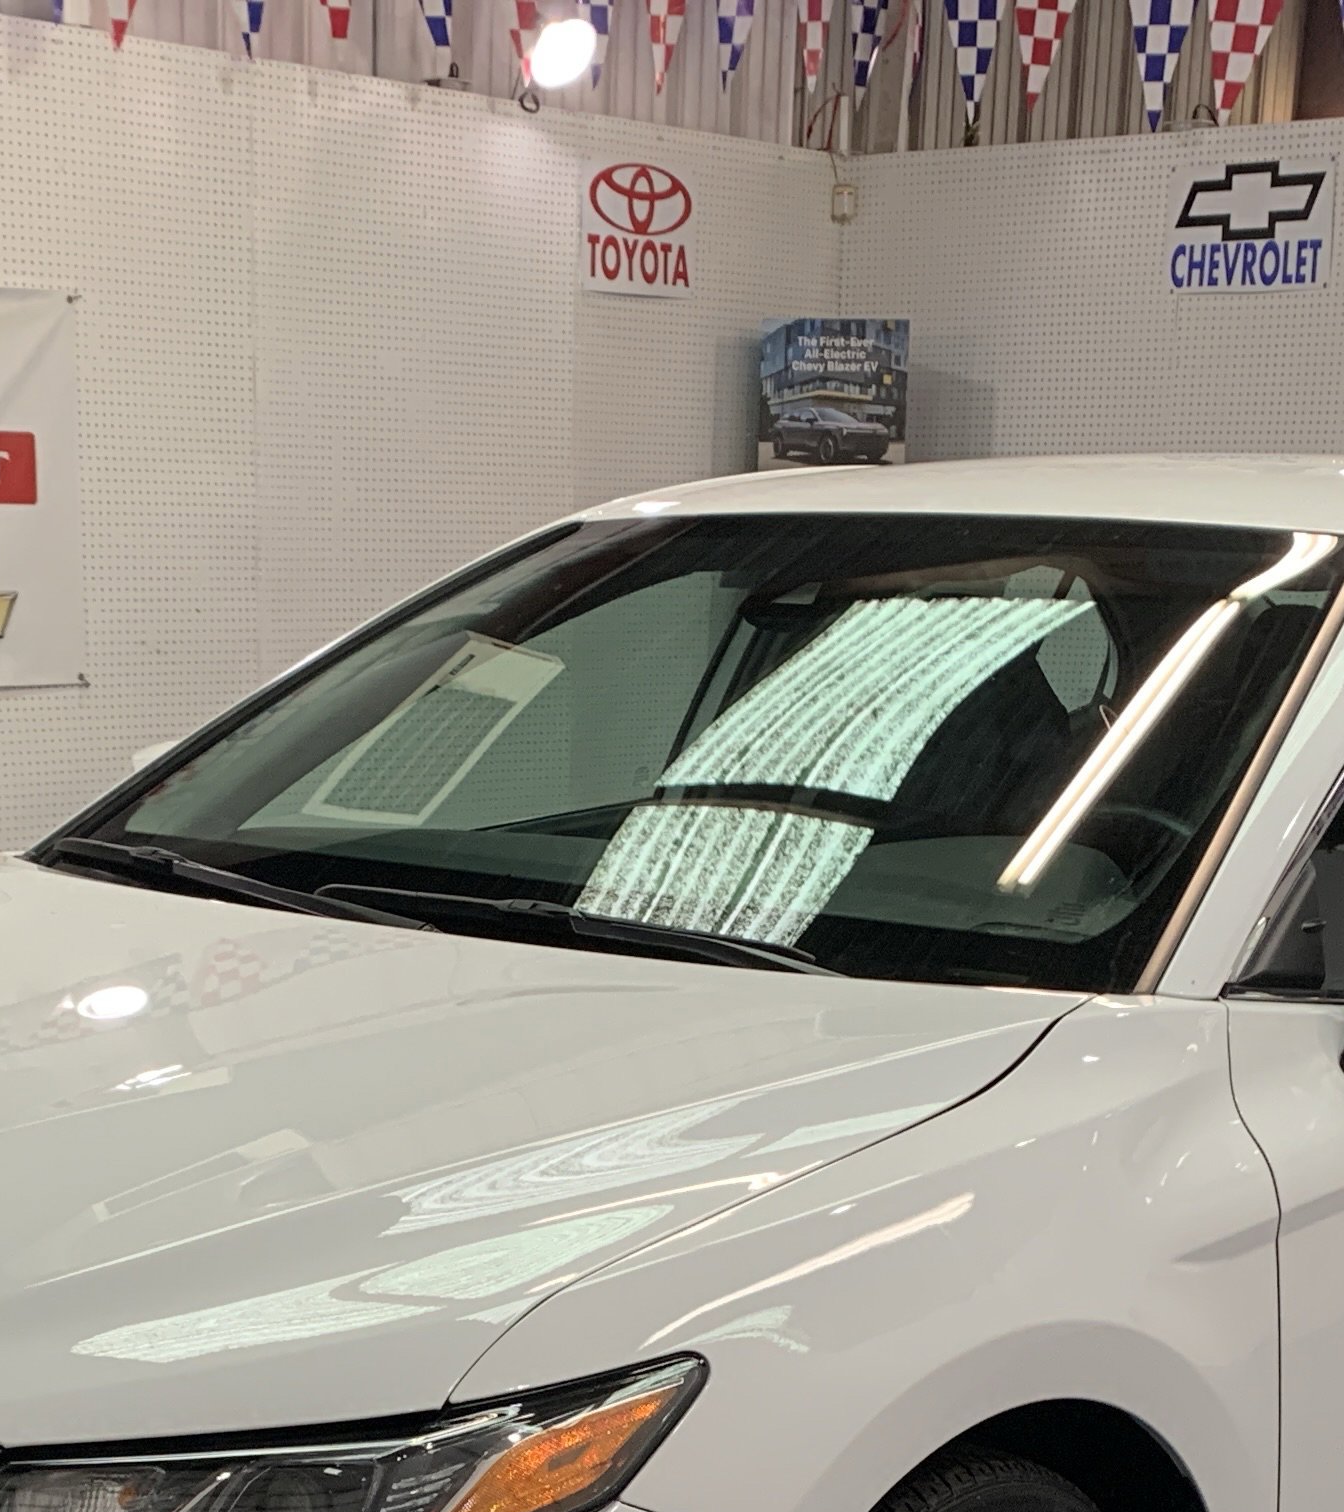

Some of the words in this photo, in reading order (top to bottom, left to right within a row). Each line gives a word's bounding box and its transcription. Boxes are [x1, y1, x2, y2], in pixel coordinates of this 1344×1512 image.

[587, 233, 689, 287] TOYOTA
[1171, 239, 1322, 288] CHEVROLET
[798, 336, 817, 346] The
[820, 336, 875, 347] First-Ever
[804, 349, 866, 359] All-Electric
[792, 360, 825, 373] Chevy
[827, 361, 862, 371] Blazer
[863, 361, 879, 372] EV
